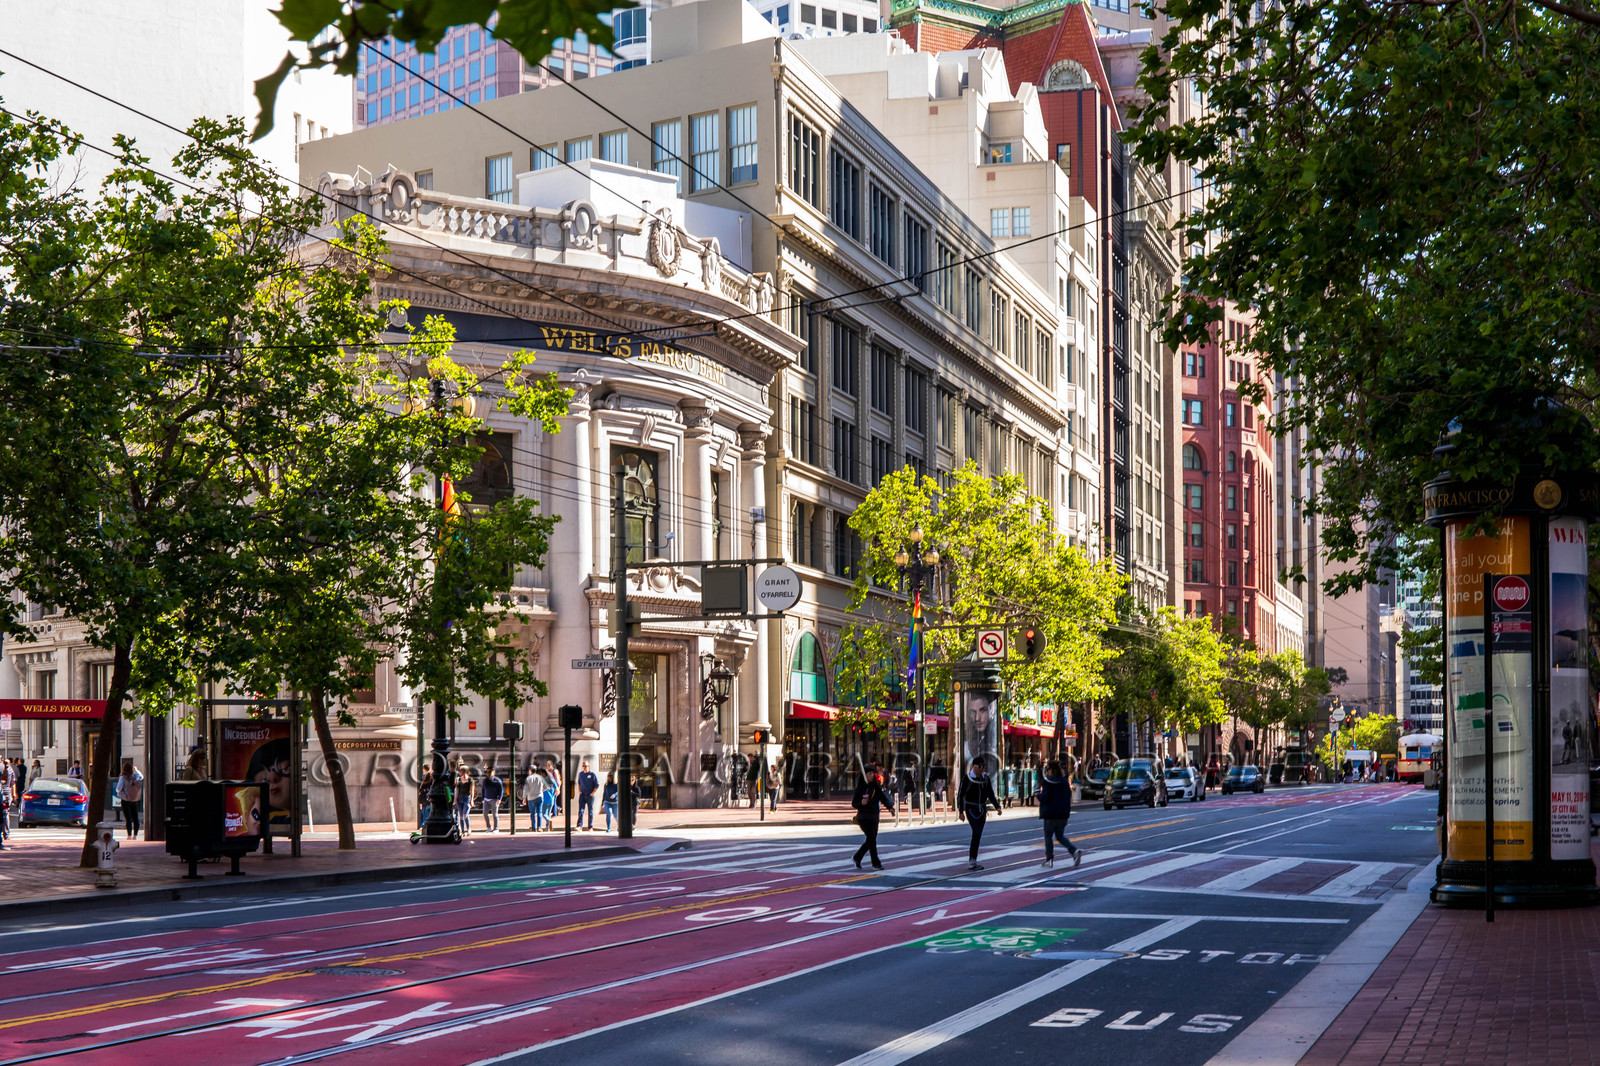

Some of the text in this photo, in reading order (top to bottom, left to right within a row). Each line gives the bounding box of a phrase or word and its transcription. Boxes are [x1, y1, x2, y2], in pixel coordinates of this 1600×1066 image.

[540, 327, 727, 387] WELLS FARGO BANK
[1438, 489, 1510, 508] FRANCISCO
[1579, 487, 1599, 504] SAN
[1461, 553, 1474, 567] all
[1478, 553, 1514, 569] your
[764, 579, 791, 587] GRANT
[760, 591, 795, 599] O'FARRELL
[23, 705, 92, 713] WELLS FARGO
[224, 727, 270, 740] INCREDIBLES 2
[1463, 777, 1476, 785] GET
[1476, 777, 1482, 785] 2
[1551, 791, 1565, 803] MAY
[1551, 804, 1579, 814] SF CITY HALL
[102, 851, 111, 861] 12
[684, 905, 994, 926] ONLY
[1140, 948, 1329, 966] STOP
[86, 996, 552, 1045] TAXI
[1028, 1007, 1243, 1033] BUS
